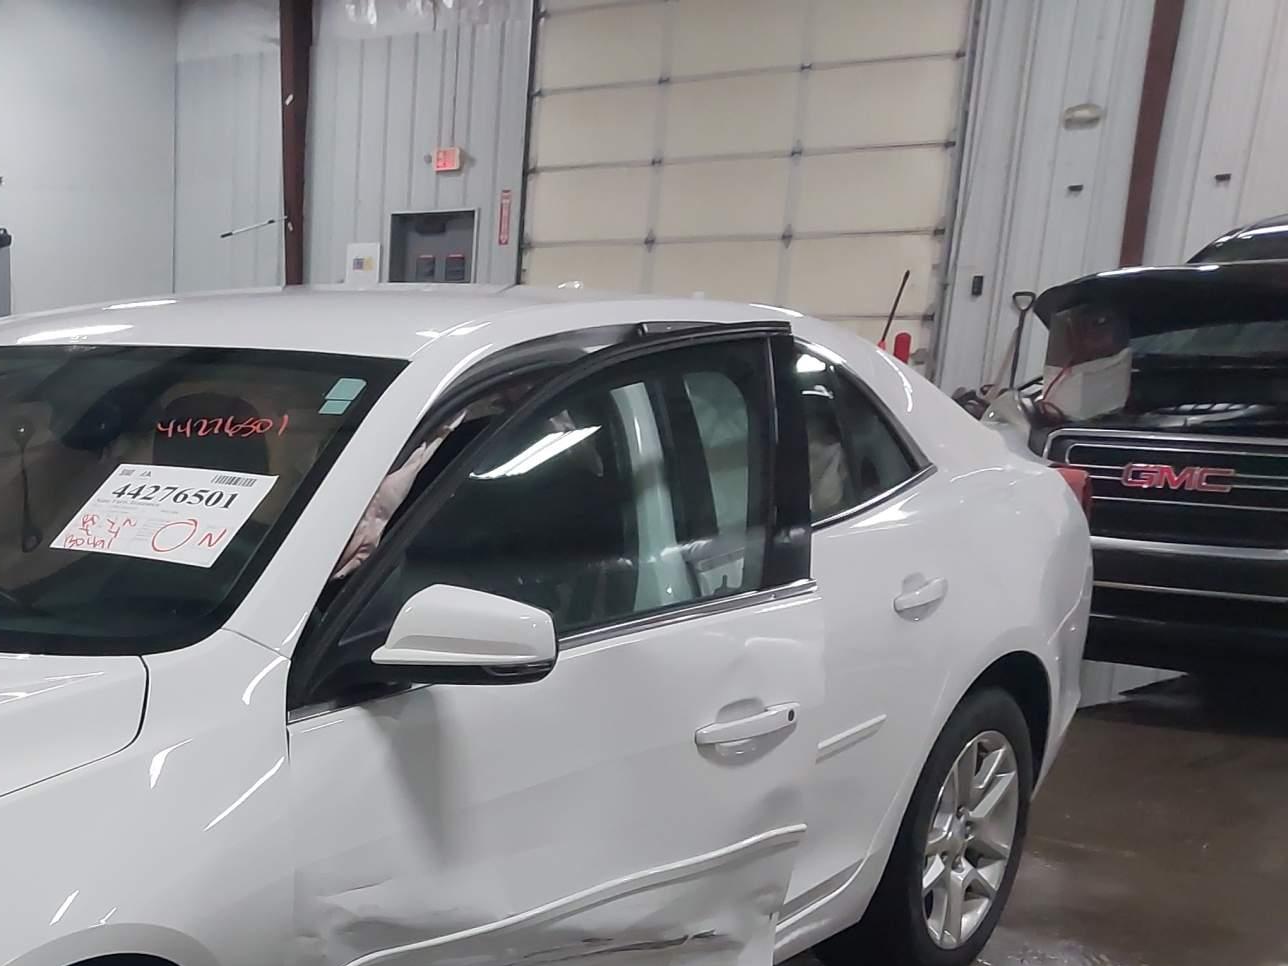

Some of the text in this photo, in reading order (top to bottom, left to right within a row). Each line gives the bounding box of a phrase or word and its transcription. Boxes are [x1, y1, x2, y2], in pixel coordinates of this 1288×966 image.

[156, 414, 289, 438] 44276501
[1122, 463, 1237, 493] GMC
[112, 483, 239, 509] 44276501
